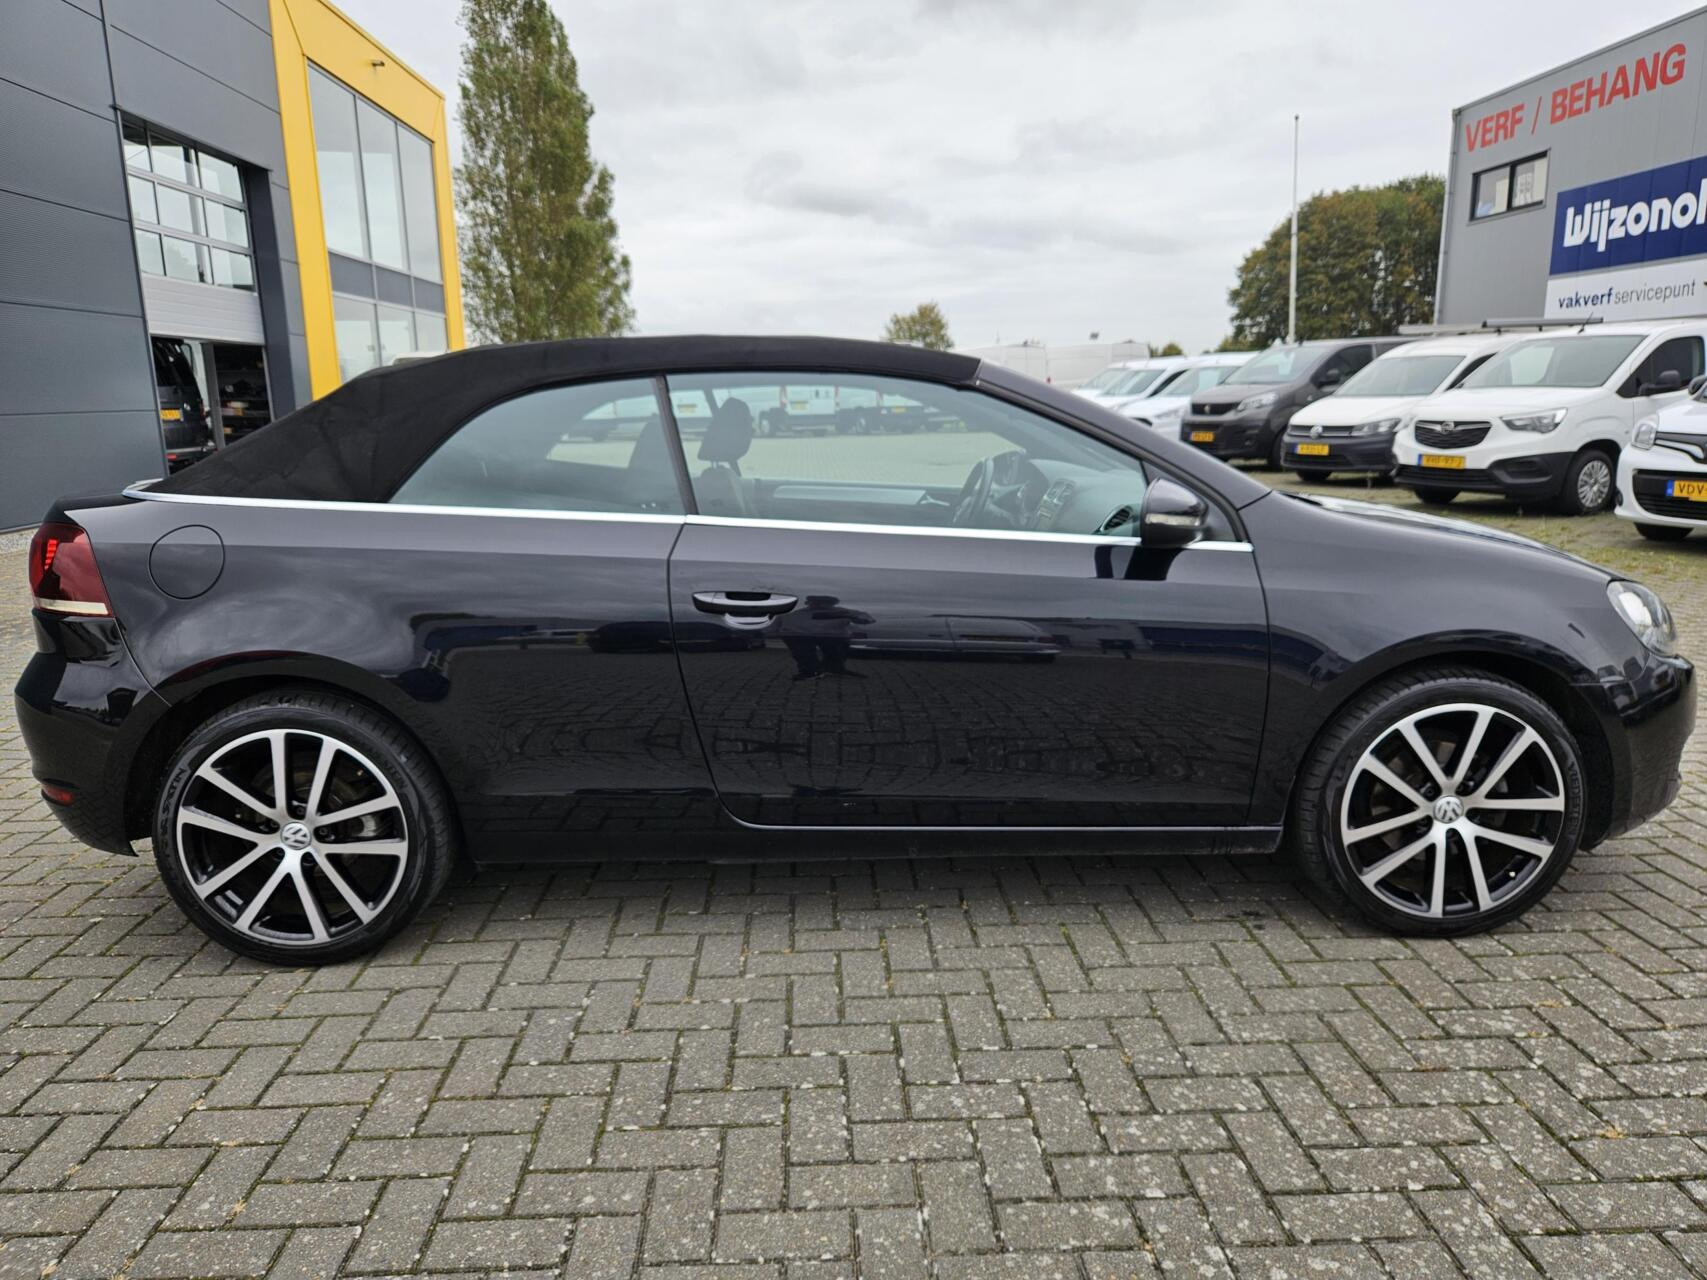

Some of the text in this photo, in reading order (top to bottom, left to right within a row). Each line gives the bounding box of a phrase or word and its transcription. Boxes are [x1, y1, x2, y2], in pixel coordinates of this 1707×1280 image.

[1465, 43, 1686, 152] VERF / BEHANG
